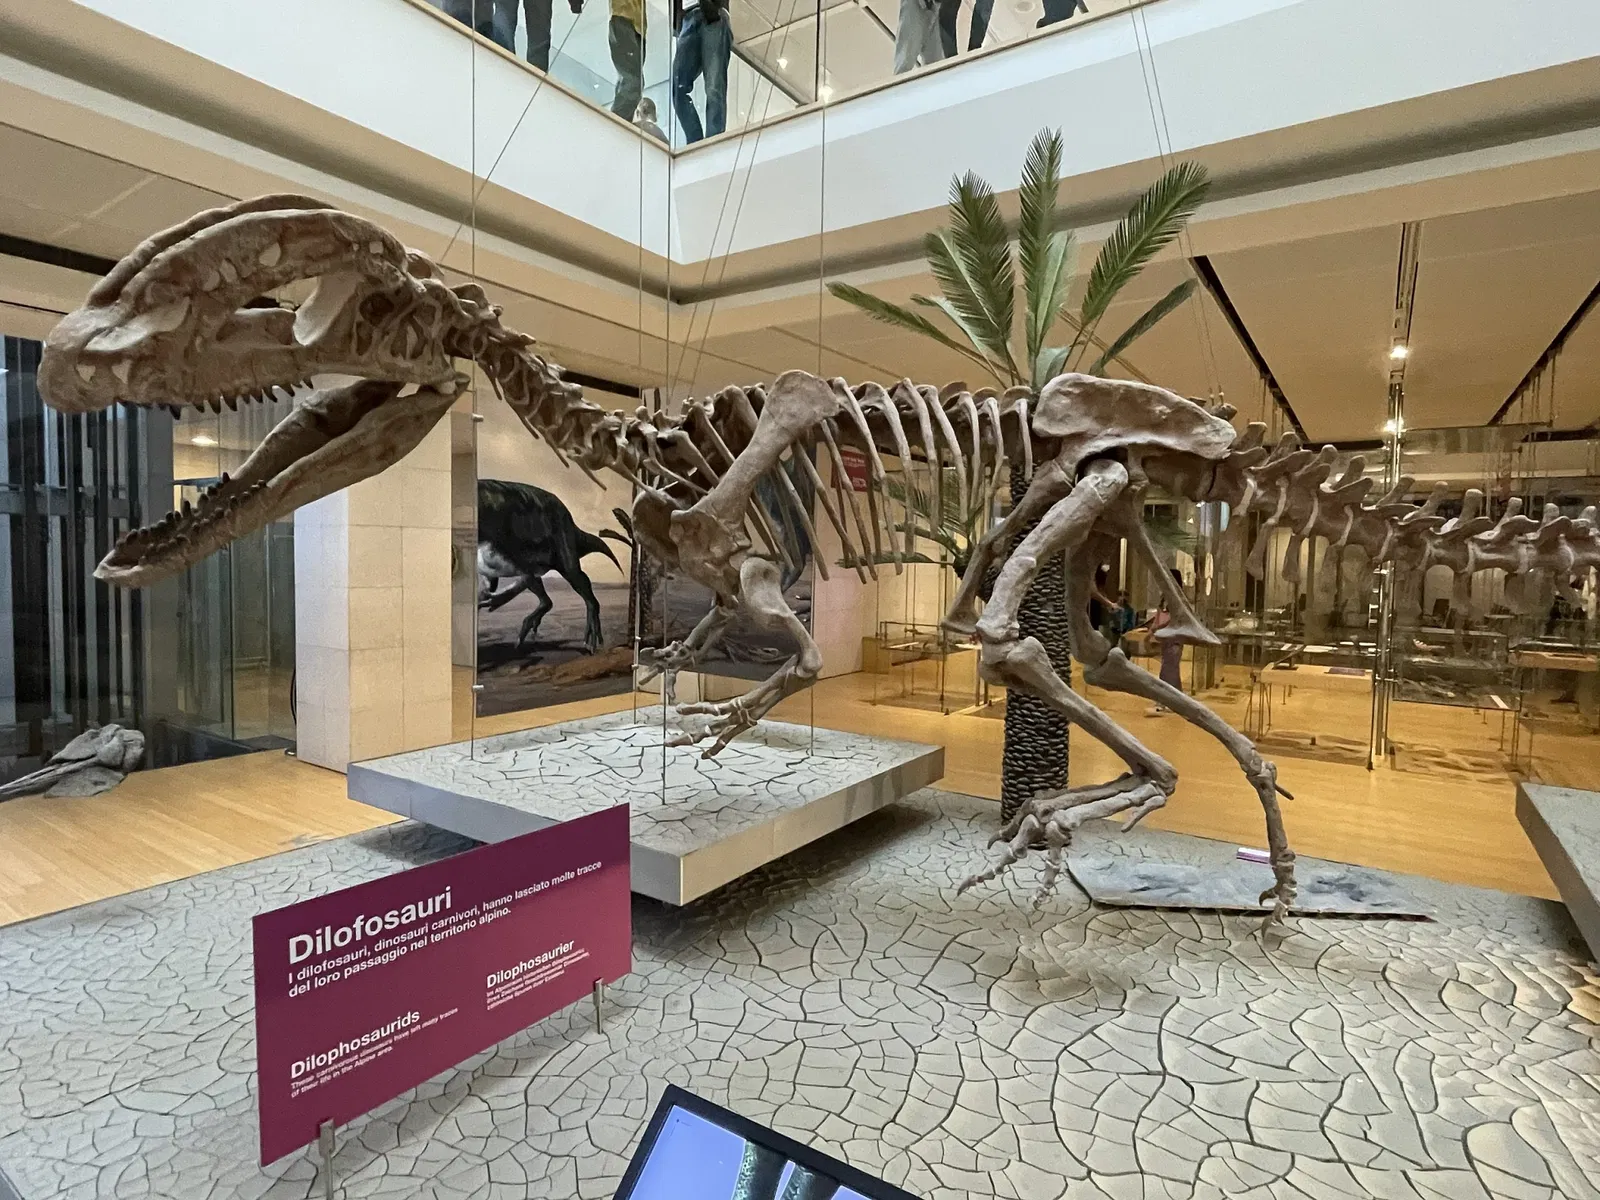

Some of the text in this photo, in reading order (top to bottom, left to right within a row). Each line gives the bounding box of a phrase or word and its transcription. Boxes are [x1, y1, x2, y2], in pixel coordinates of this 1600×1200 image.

[288, 861, 602, 984] I dilofosauri, dinosauri carnivori, hanno lasciato molte tracce
[288, 907, 511, 998] del loro passaggio nel territorio alpino.
[289, 886, 451, 965] Dilofosauri
[487, 940, 574, 988] Dilophosaurier
[291, 1011, 420, 1079] Dilophosaurids
